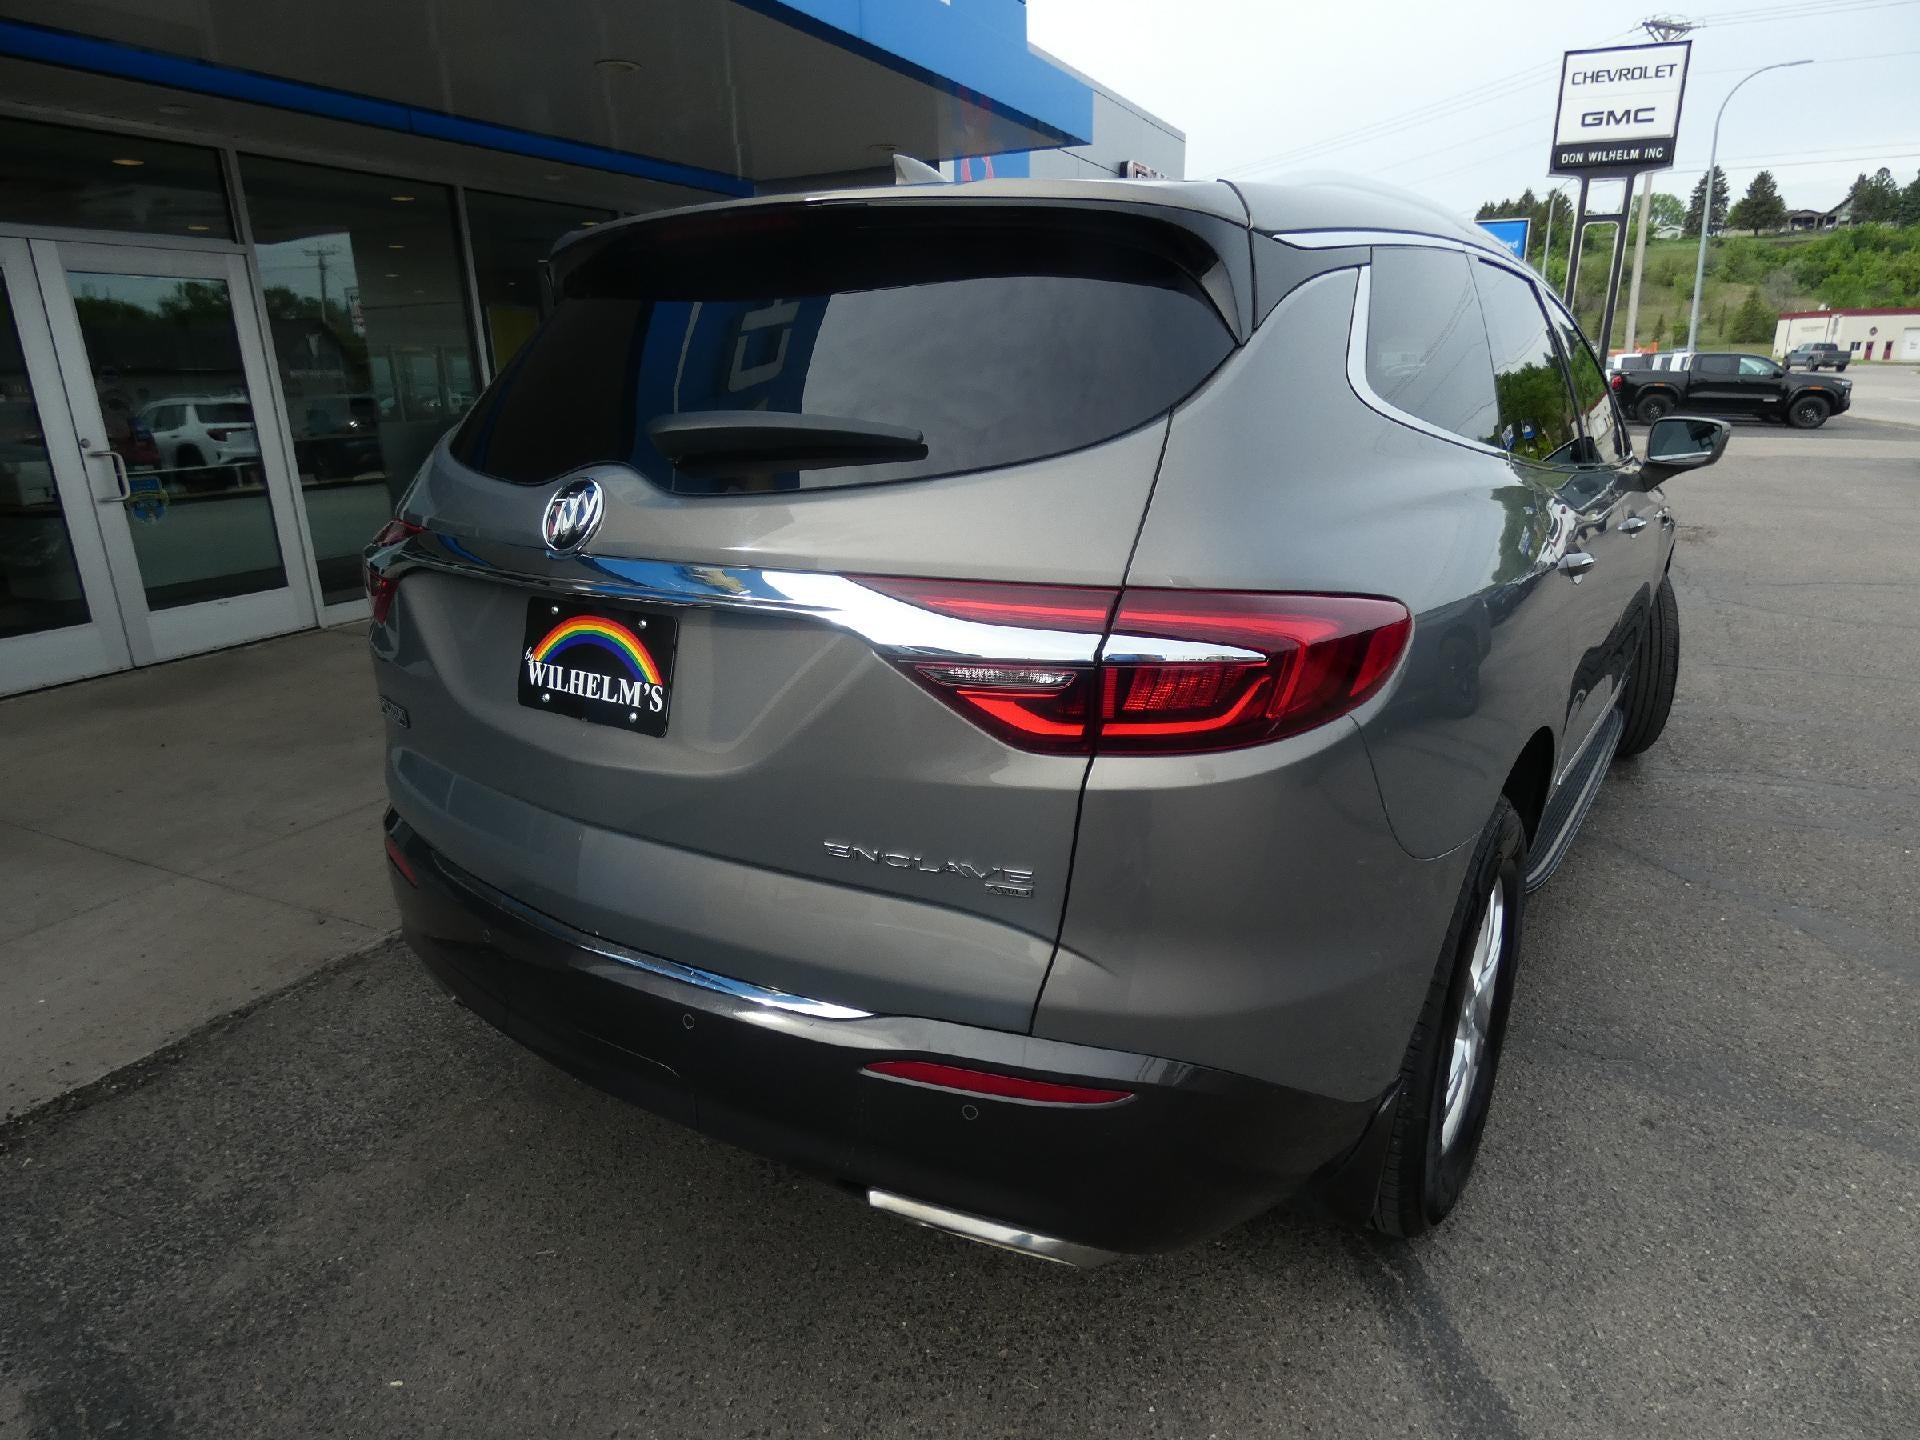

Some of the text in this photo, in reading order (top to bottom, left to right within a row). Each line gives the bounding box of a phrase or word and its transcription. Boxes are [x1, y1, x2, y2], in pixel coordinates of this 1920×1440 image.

[1572, 64, 1677, 85] CHEVROLET
[1581, 107, 1655, 127] GMC
[1561, 147, 1664, 164] DON WILHELM INC
[528, 661, 663, 712] WILHELM'S
[823, 840, 1033, 883] ENCLAVE
